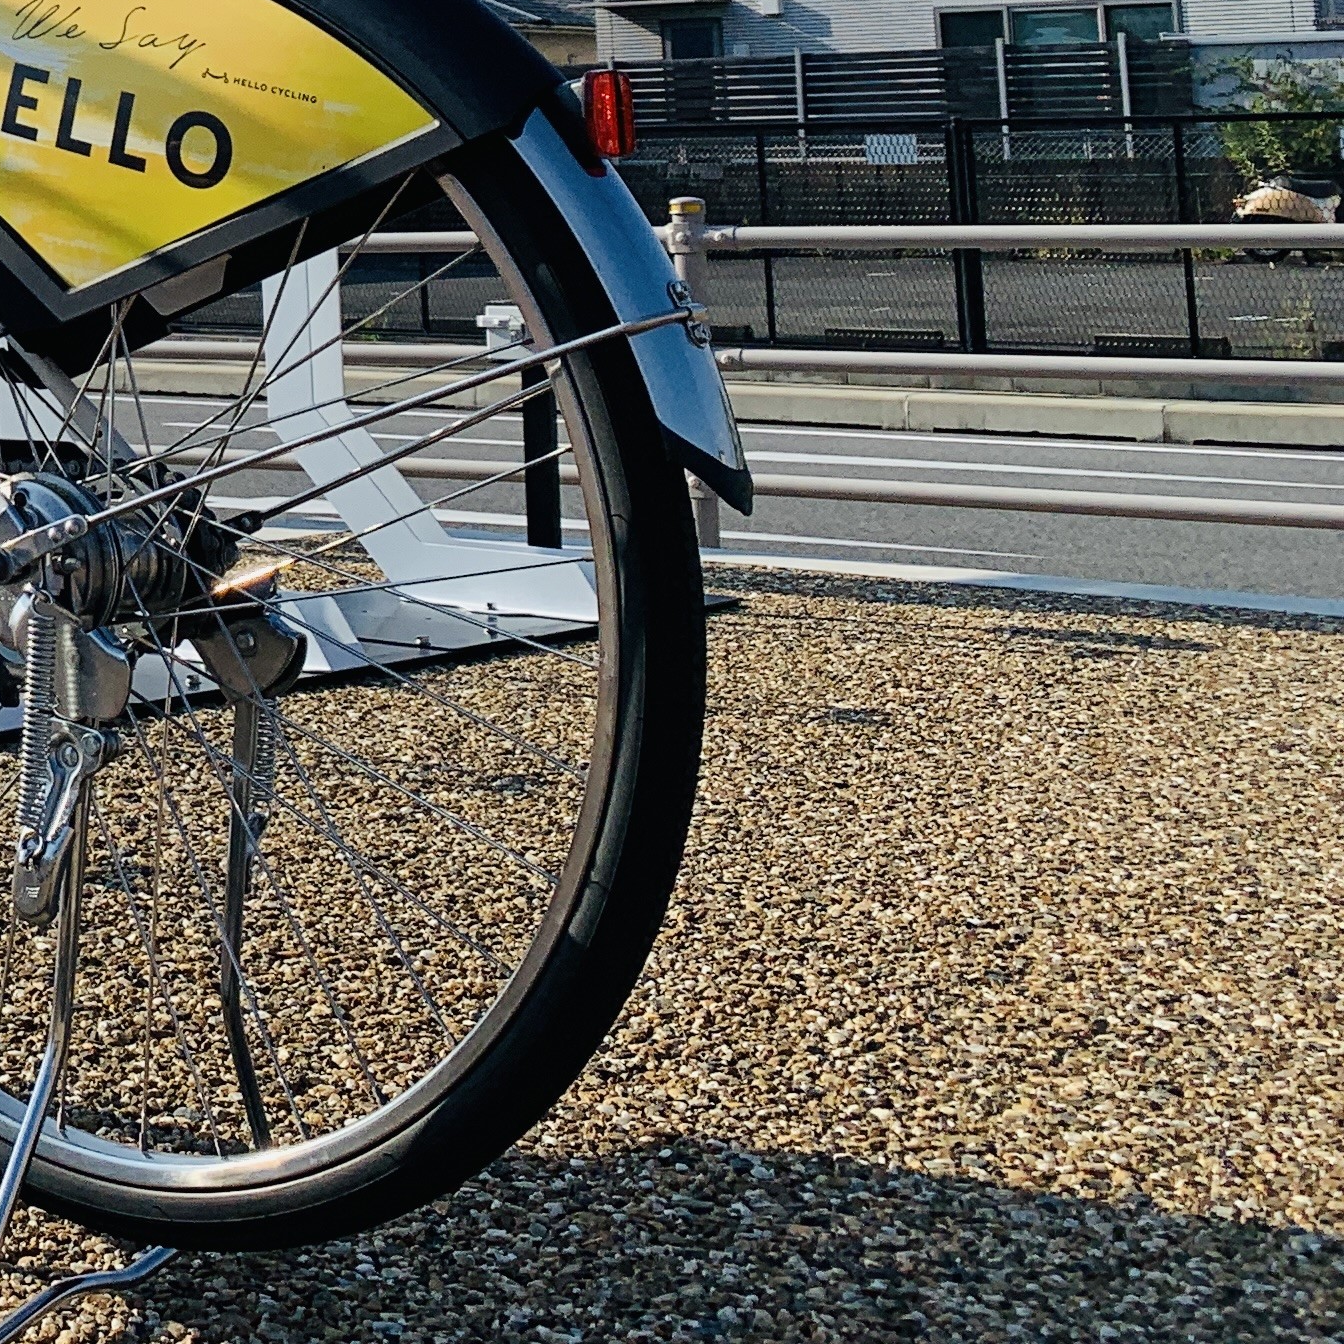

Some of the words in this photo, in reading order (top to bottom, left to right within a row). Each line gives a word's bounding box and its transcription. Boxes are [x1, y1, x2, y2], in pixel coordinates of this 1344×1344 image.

[98, 6, 207, 70] Say
[232, 77, 269, 92] HELLO
[270, 85, 318, 105] CYCLING
